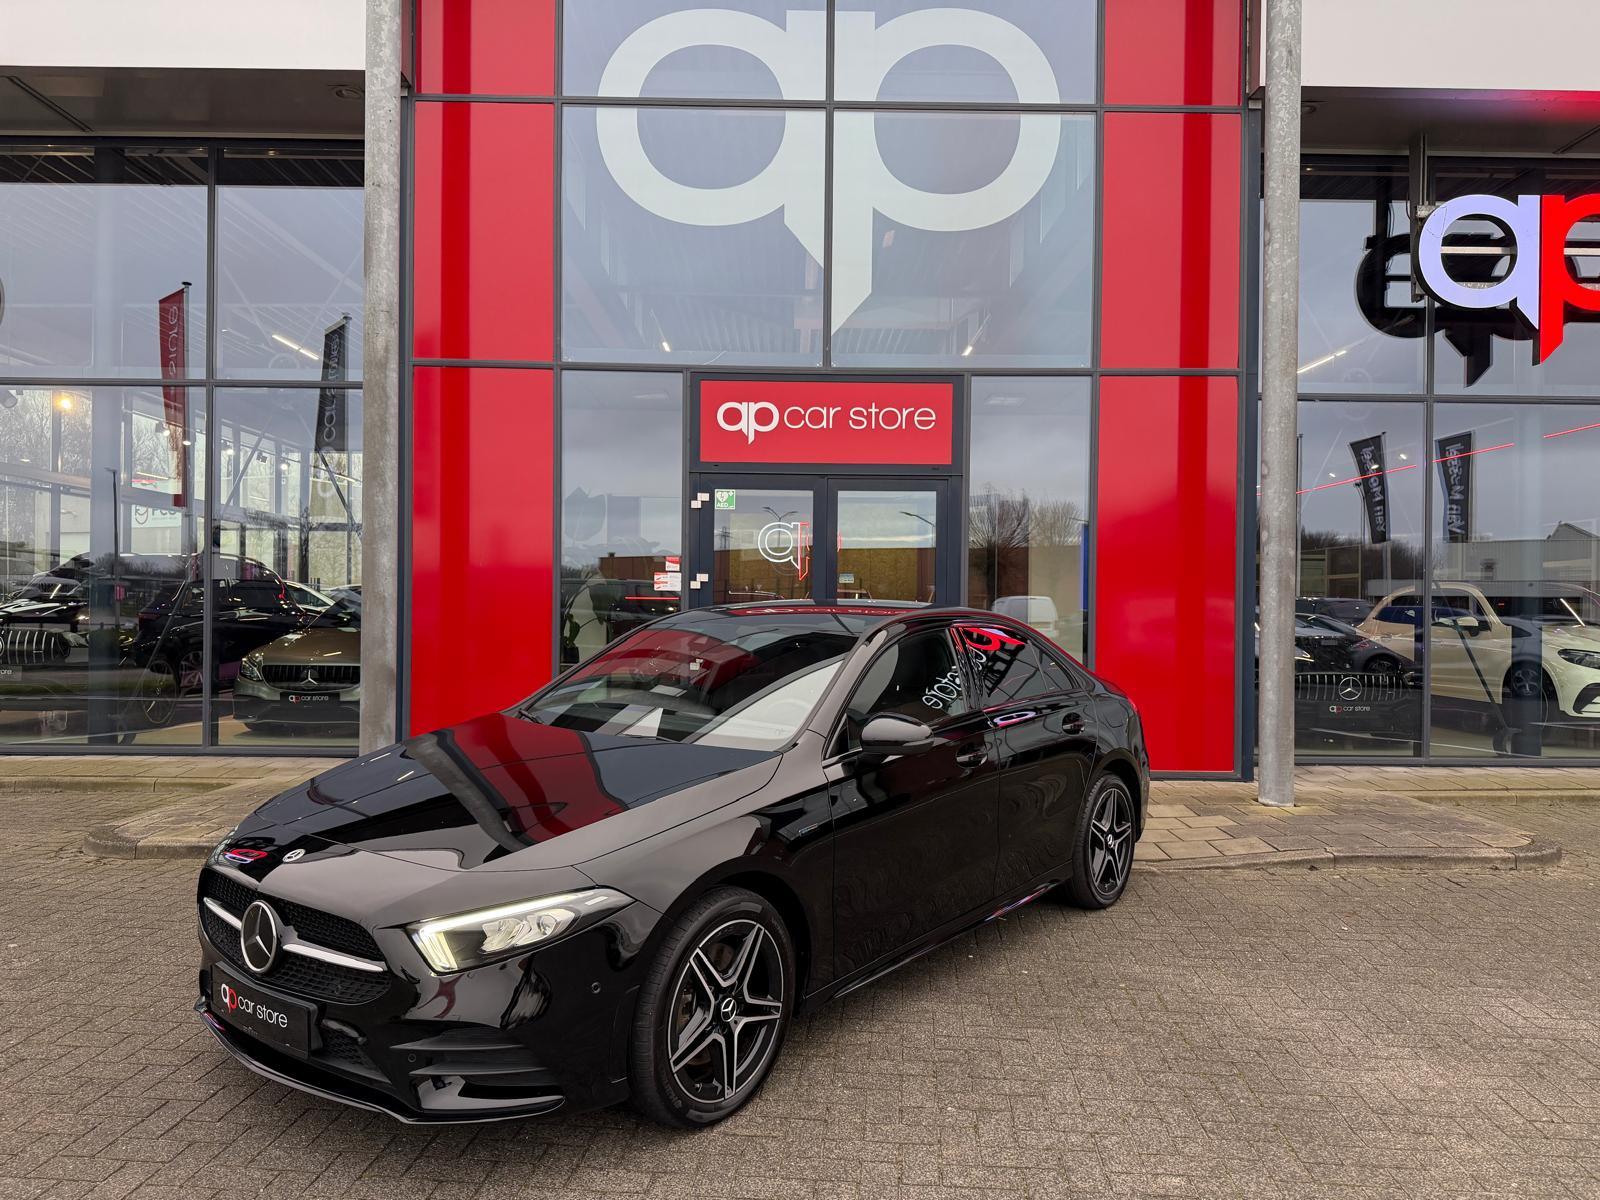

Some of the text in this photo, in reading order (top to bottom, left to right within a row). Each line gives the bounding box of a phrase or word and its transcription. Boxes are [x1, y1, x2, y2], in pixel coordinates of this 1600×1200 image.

[596, 7, 1061, 336] ap
[716, 401, 936, 445] ap car store
[221, 983, 288, 1028] ap car store
